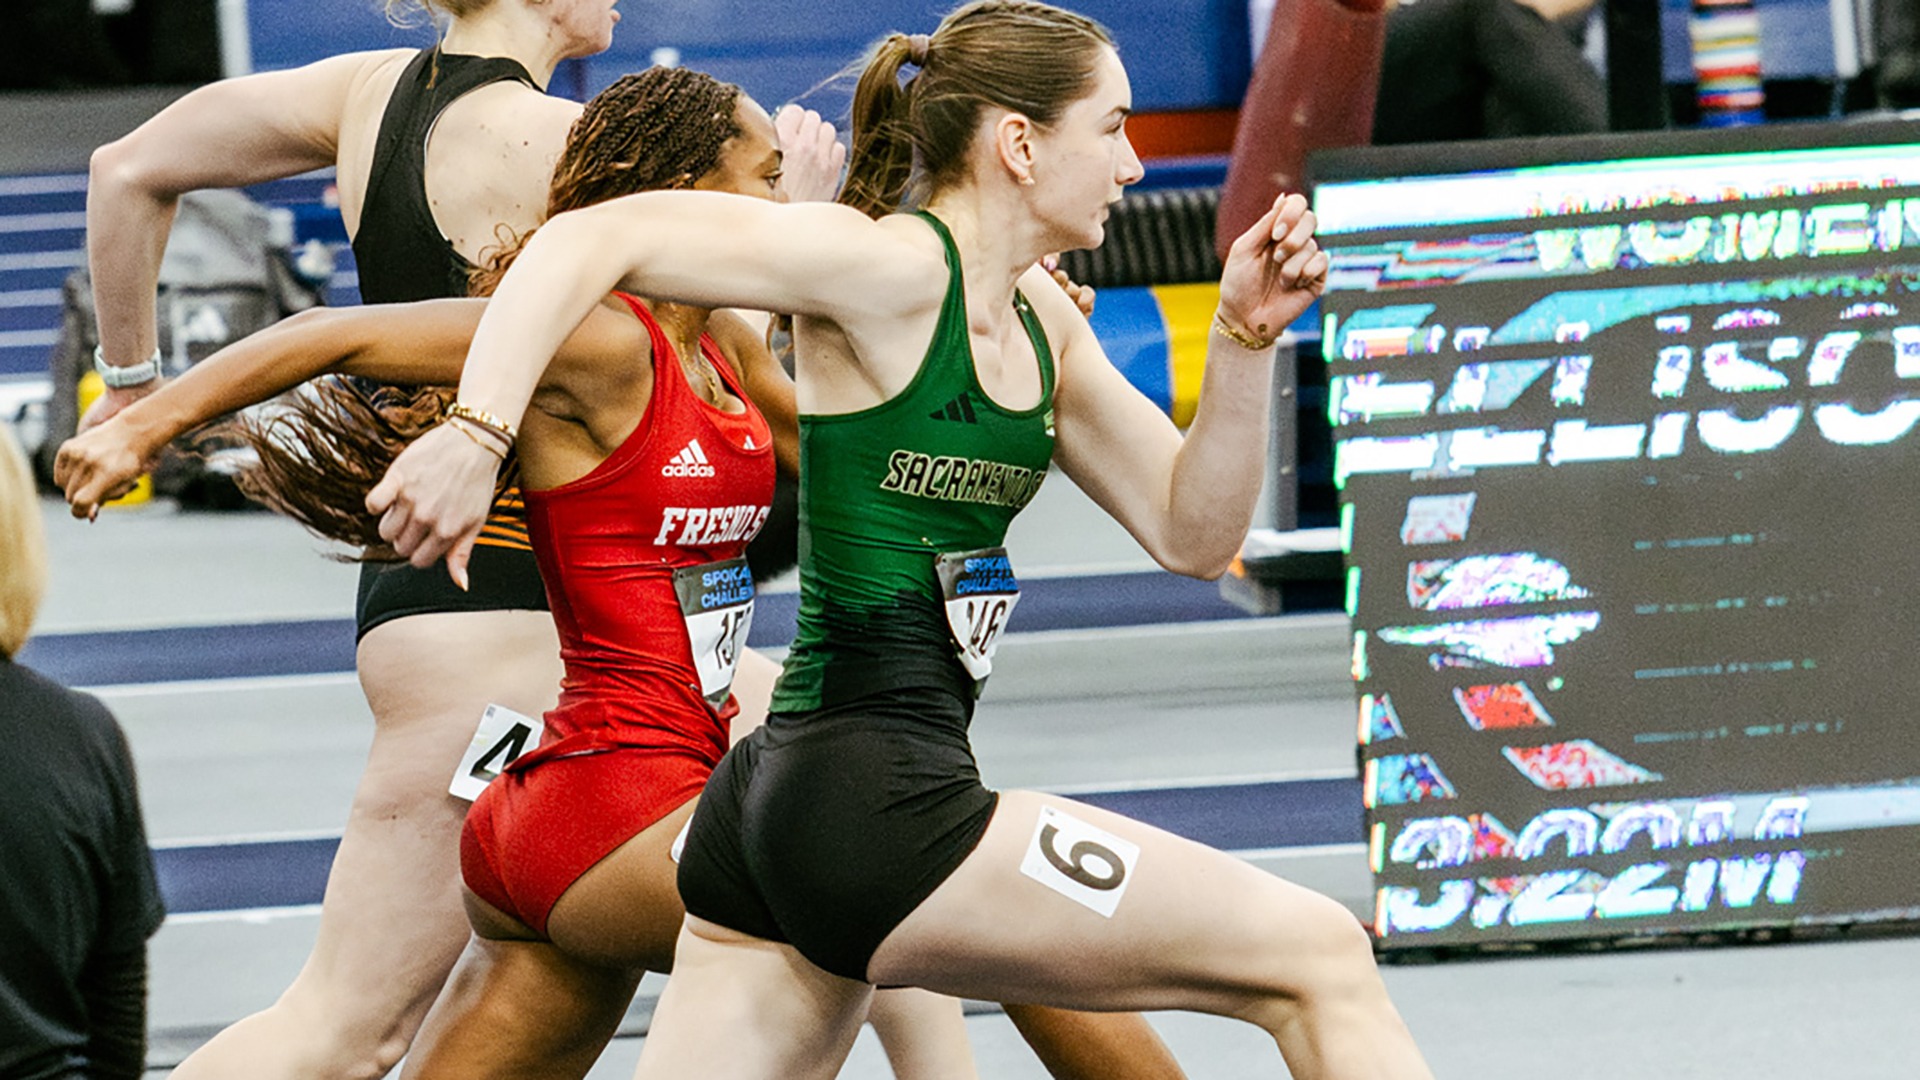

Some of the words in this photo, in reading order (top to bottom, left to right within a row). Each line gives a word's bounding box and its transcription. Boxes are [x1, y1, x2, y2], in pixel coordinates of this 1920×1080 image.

[661, 464, 716, 478] adidas
[880, 449, 1032, 508] SACRAMENTO
[653, 505, 757, 546] FRESNO
[469, 722, 531, 783] 4
[1039, 823, 1126, 891] 6
